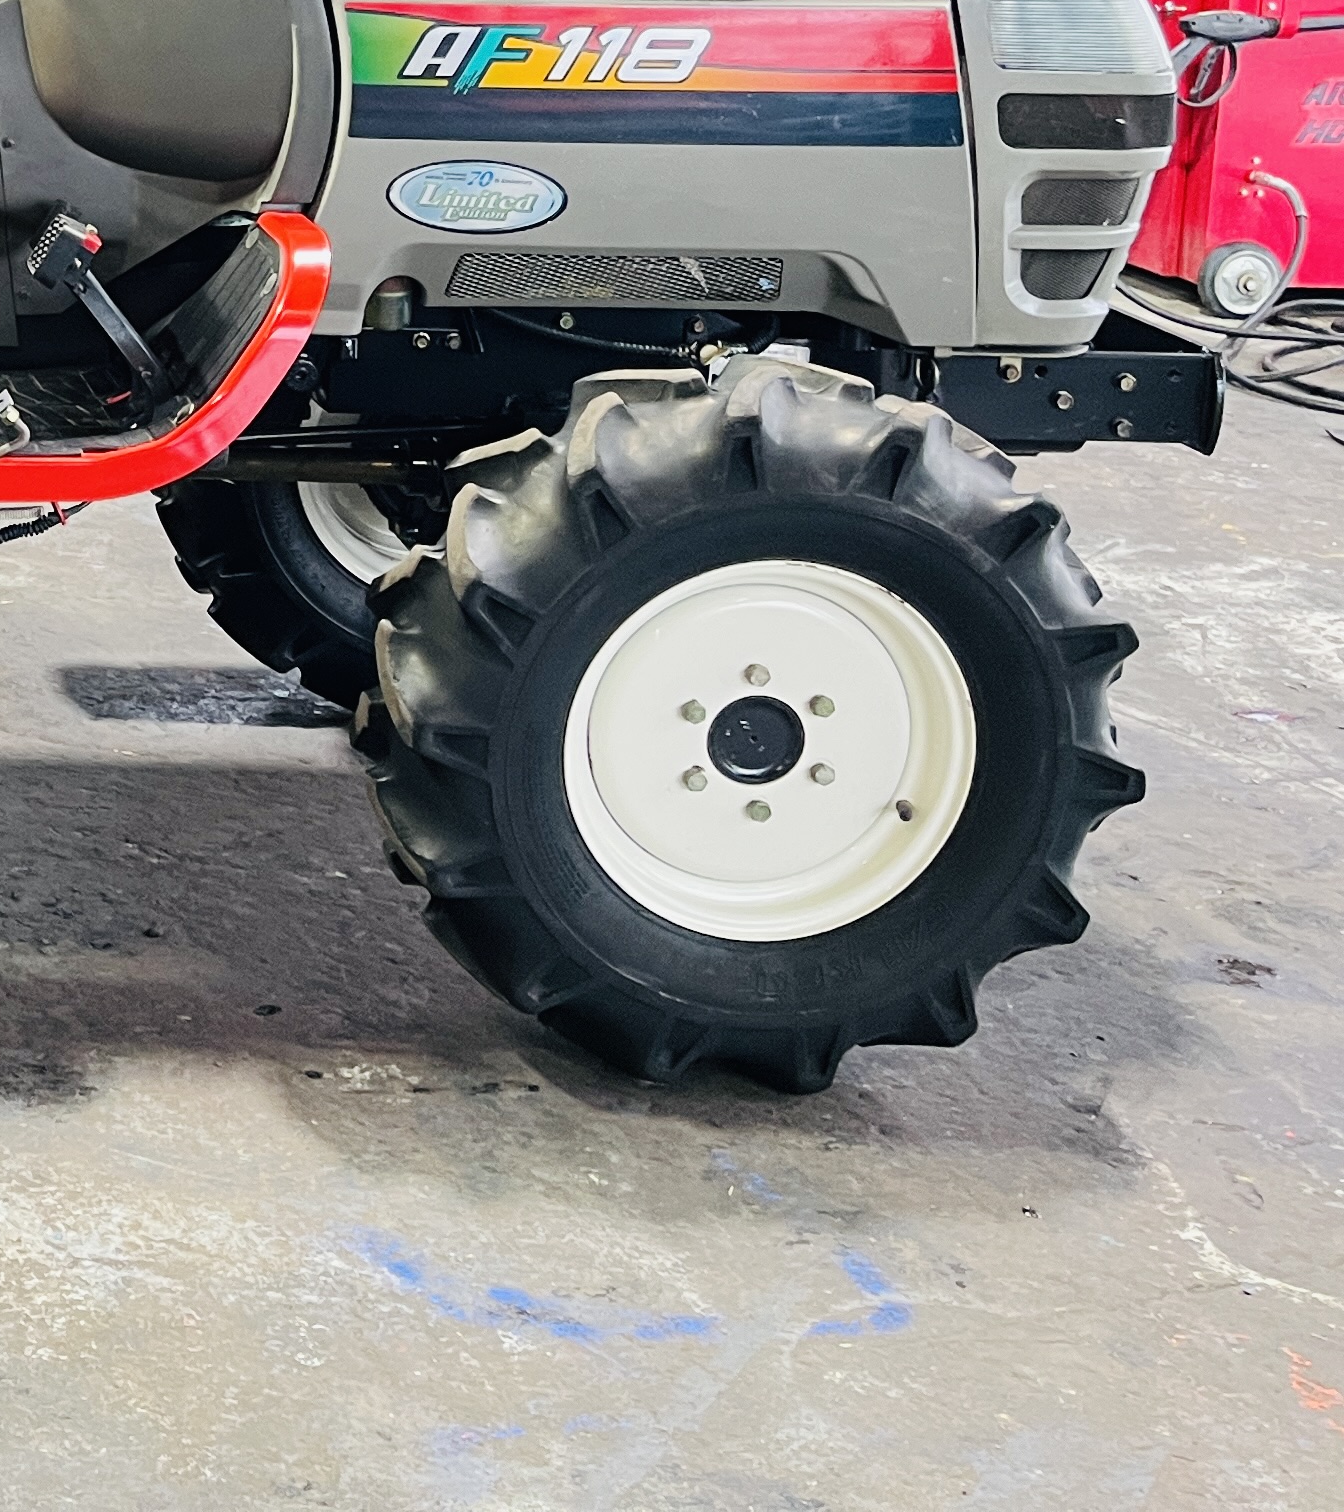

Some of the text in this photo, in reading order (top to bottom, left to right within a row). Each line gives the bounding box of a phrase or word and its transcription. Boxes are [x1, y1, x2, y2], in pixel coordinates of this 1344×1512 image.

[467, 171, 494, 187] 70
[418, 180, 539, 214] Limited
[442, 206, 509, 222] Edition
